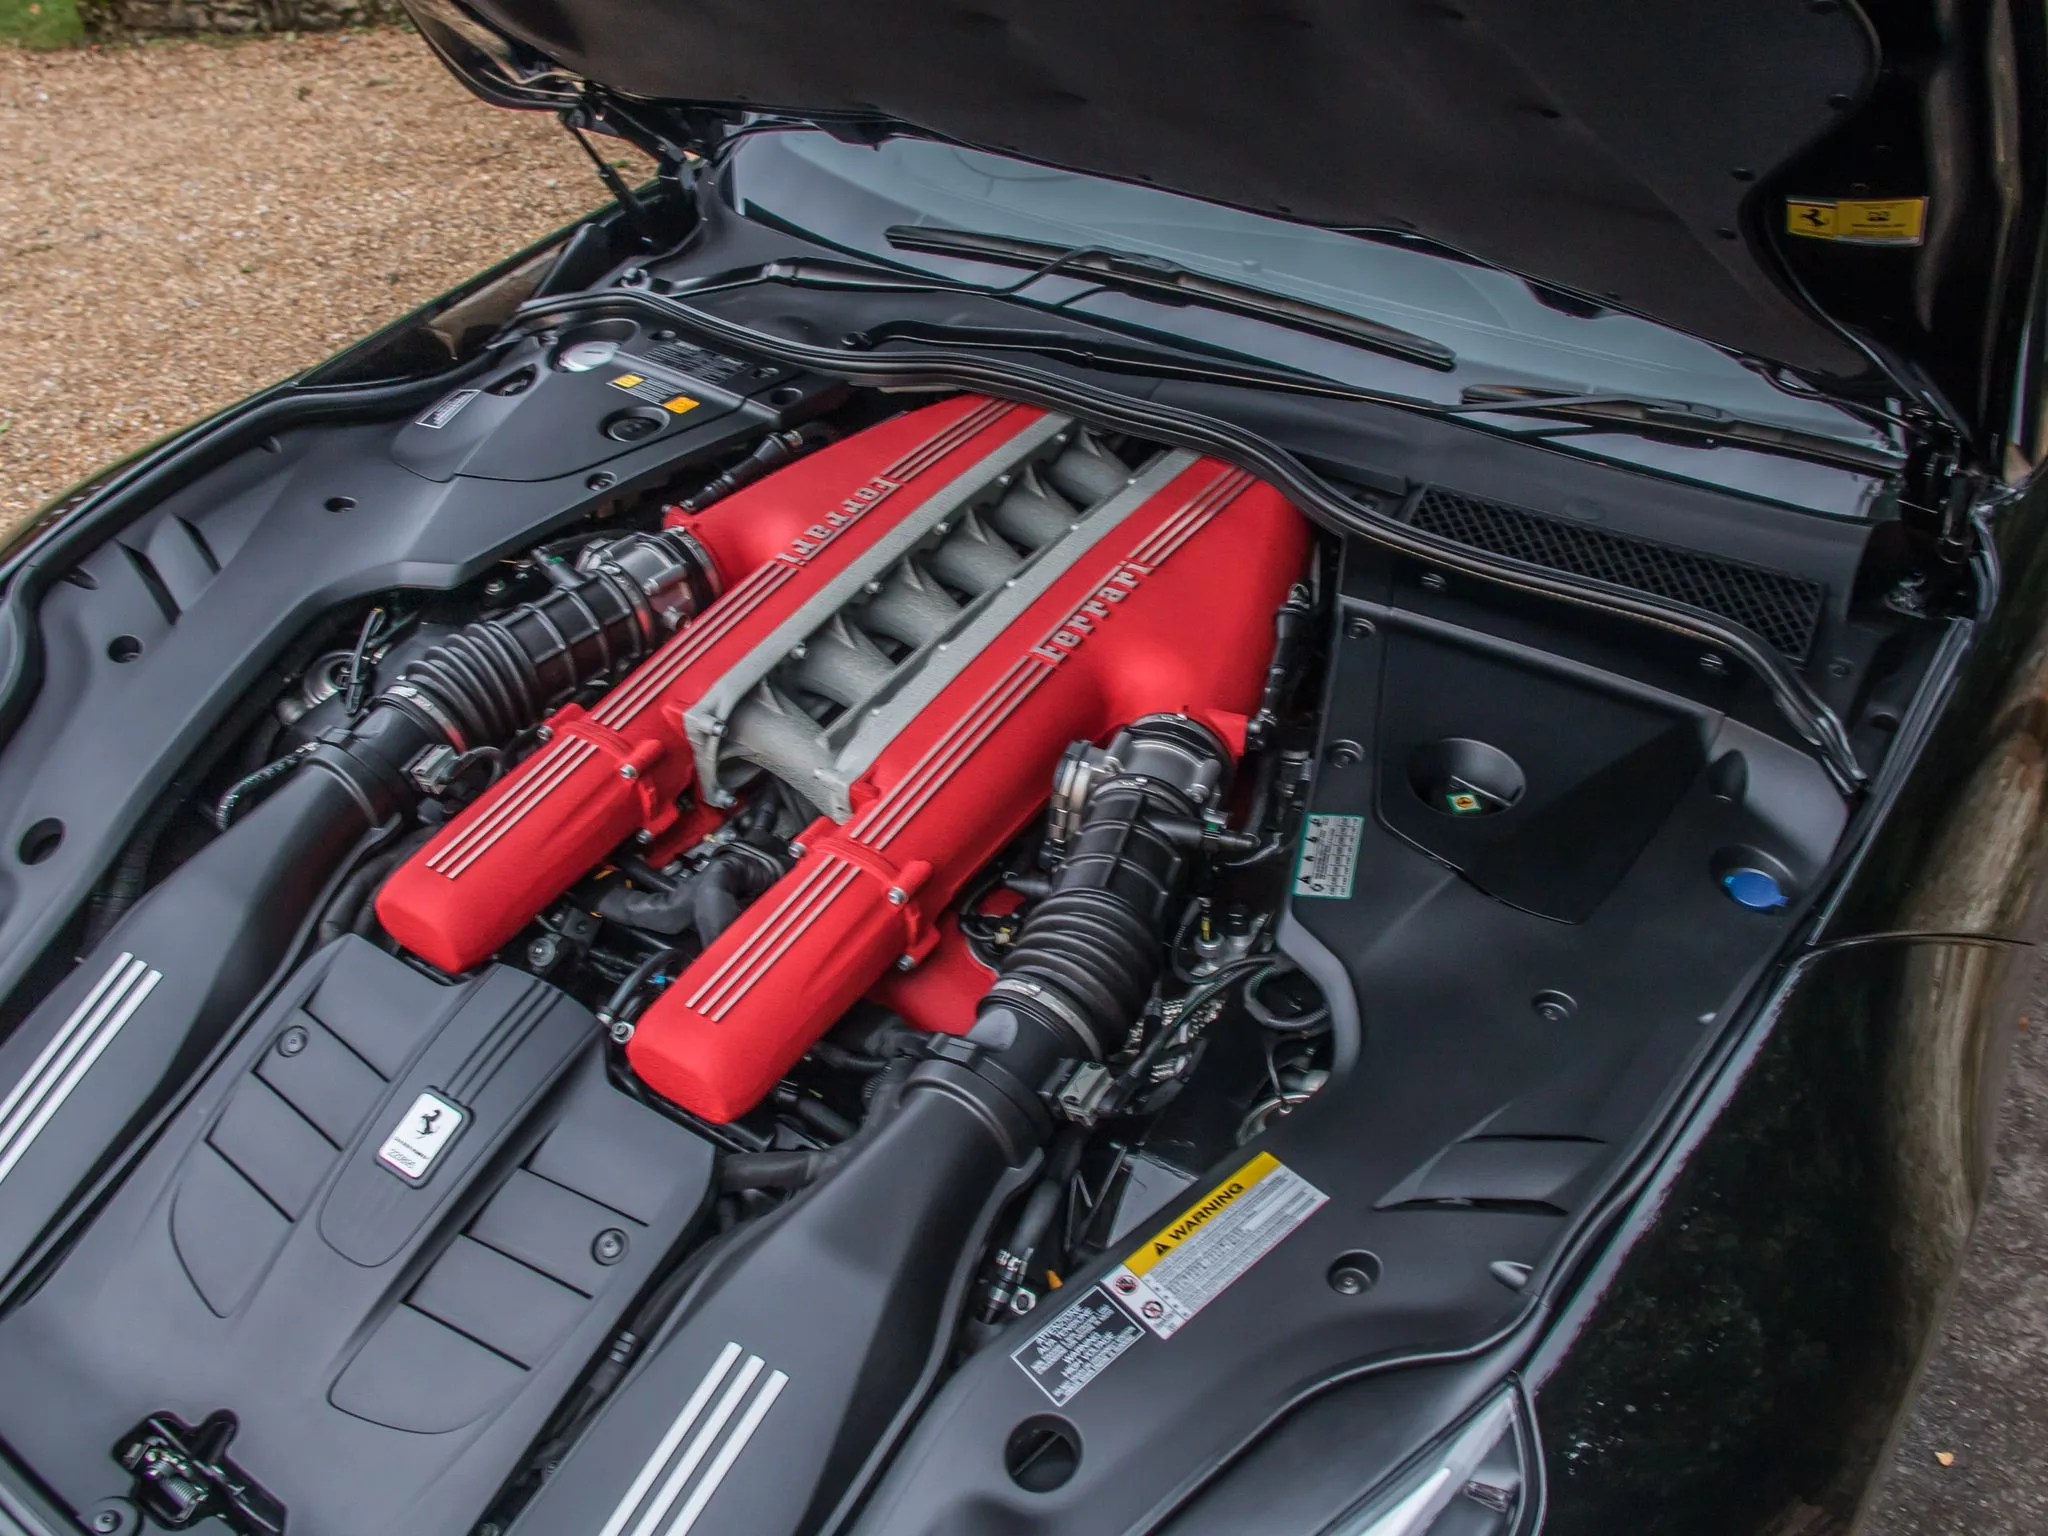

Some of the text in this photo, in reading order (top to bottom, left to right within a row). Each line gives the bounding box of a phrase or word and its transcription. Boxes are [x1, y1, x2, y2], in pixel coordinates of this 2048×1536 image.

[775, 476, 902, 566] Ferrari
[1029, 560, 1154, 661] Ferrari
[1168, 1183, 1244, 1240] WARNING
[1034, 1304, 1083, 1345] ATTENZIONE
[1061, 1330, 1101, 1364] WARNING
